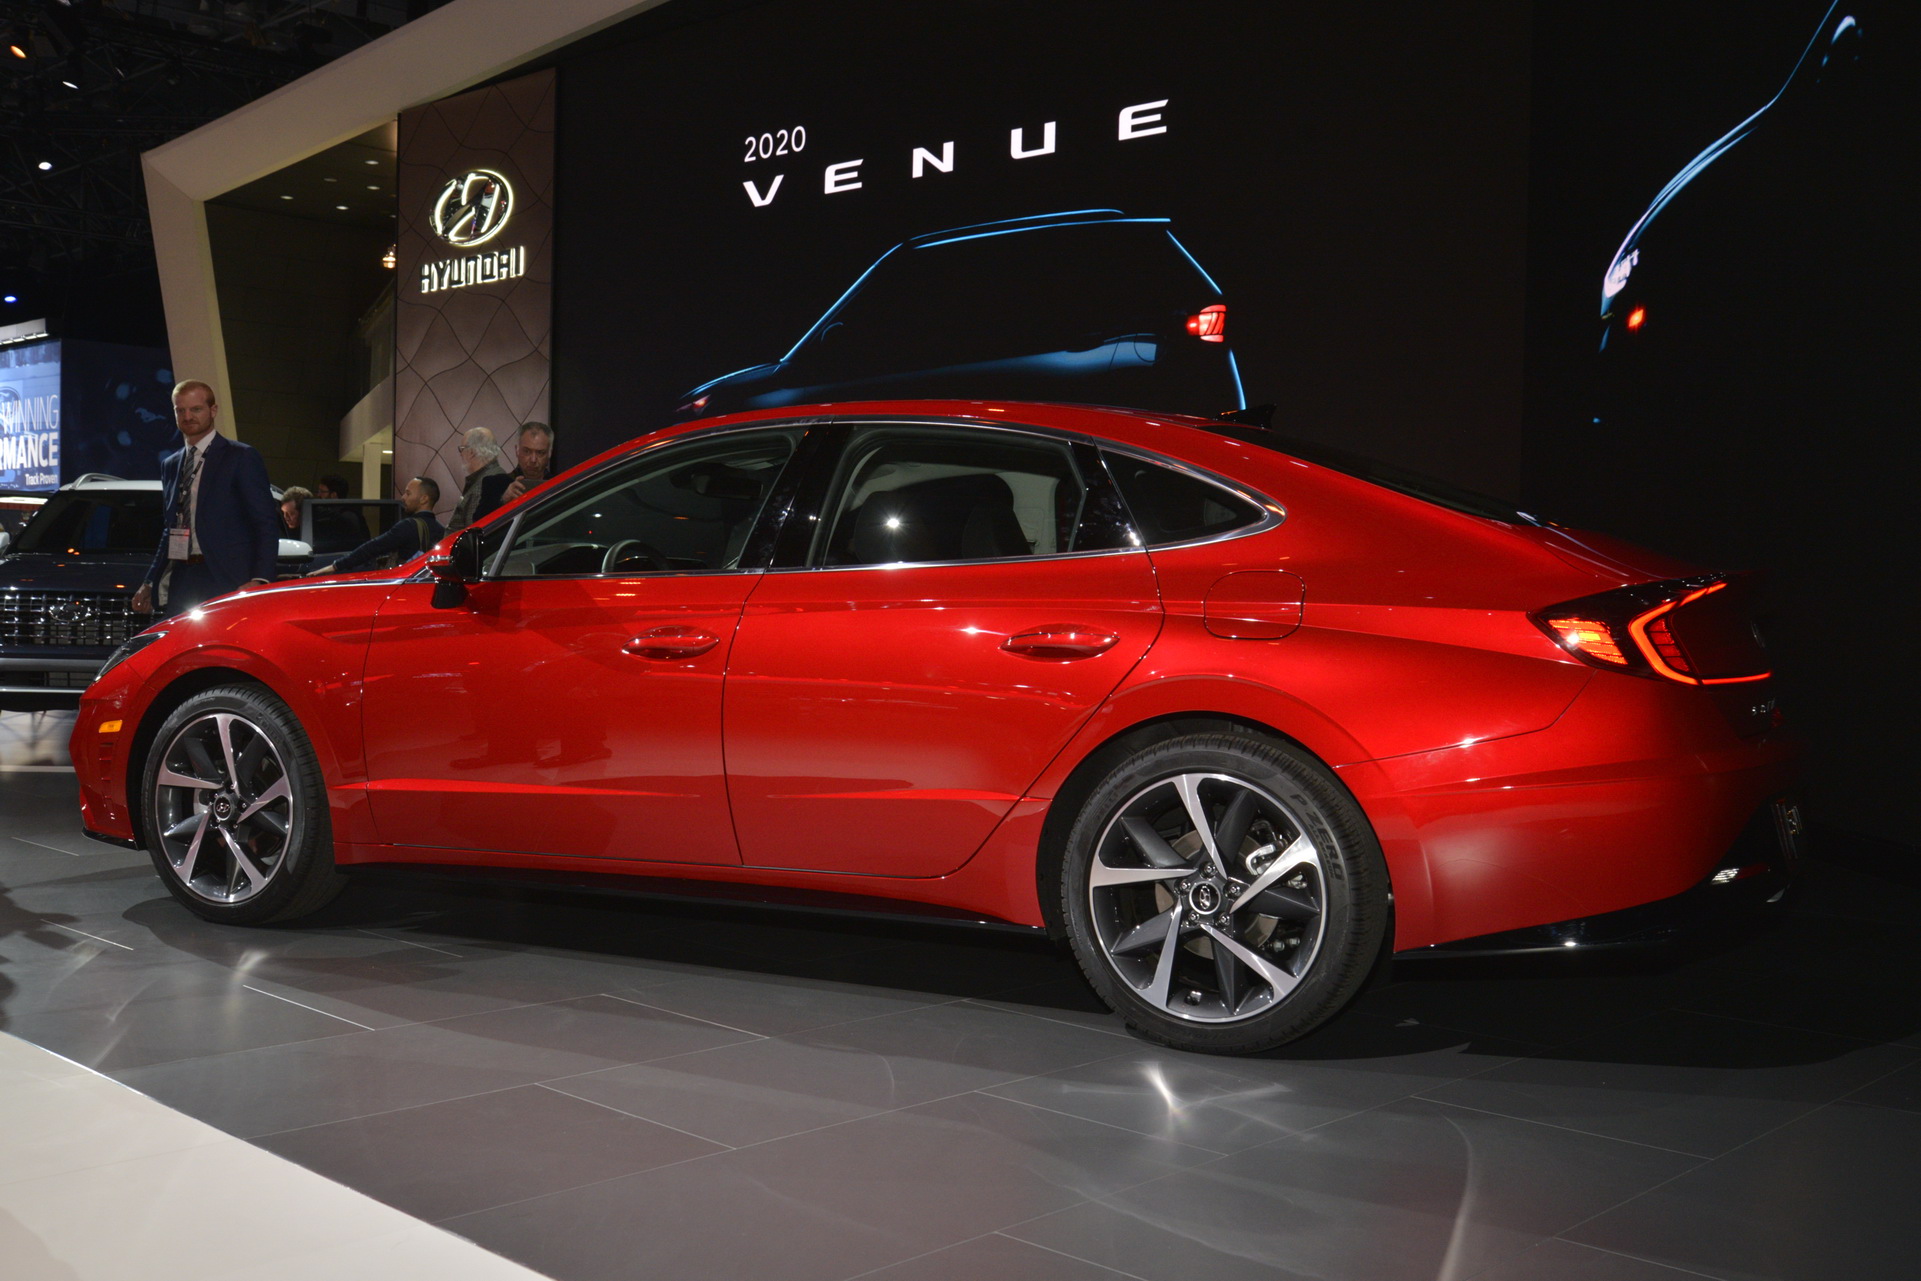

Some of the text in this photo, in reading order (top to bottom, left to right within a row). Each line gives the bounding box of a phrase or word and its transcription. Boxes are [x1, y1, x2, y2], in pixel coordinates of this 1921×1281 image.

[742, 99, 1170, 208] VENUE
[744, 125, 807, 163] 2020
[420, 244, 526, 294] HYUNDAI
[1, 394, 59, 435] WINNING
[25, 472, 39, 486] Track
[1305, 811, 1345, 881] ZERO
